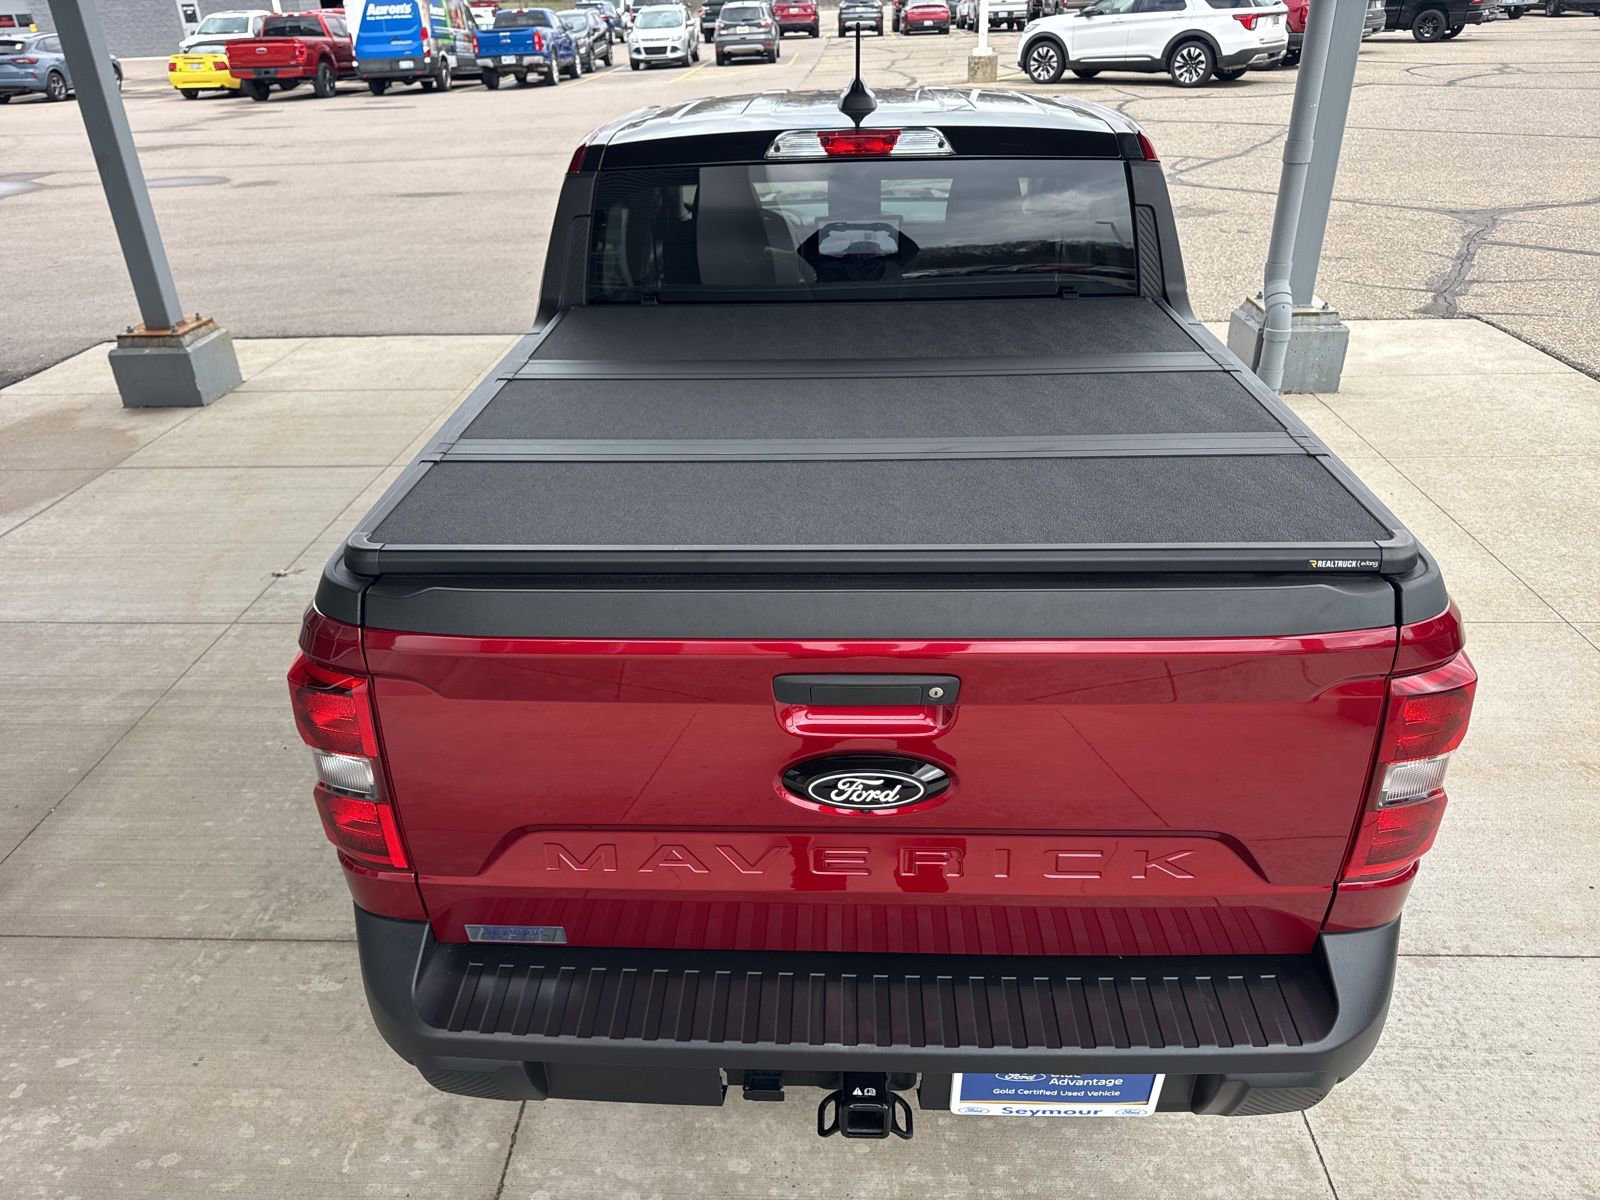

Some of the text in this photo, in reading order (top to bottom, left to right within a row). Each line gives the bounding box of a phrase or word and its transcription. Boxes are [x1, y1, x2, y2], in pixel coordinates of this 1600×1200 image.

[366, 3, 413, 15] Aaron's
[1317, 560, 1357, 568] REALTRUCK
[830, 777, 901, 802] Ford
[543, 842, 1196, 879] MAVERICK
[1048, 1077, 1124, 1087] Advantage
[1018, 1088, 1058, 1096] Certified
[1060, 1089, 1085, 1097] Used
[1001, 1106, 1103, 1117] Seymour
